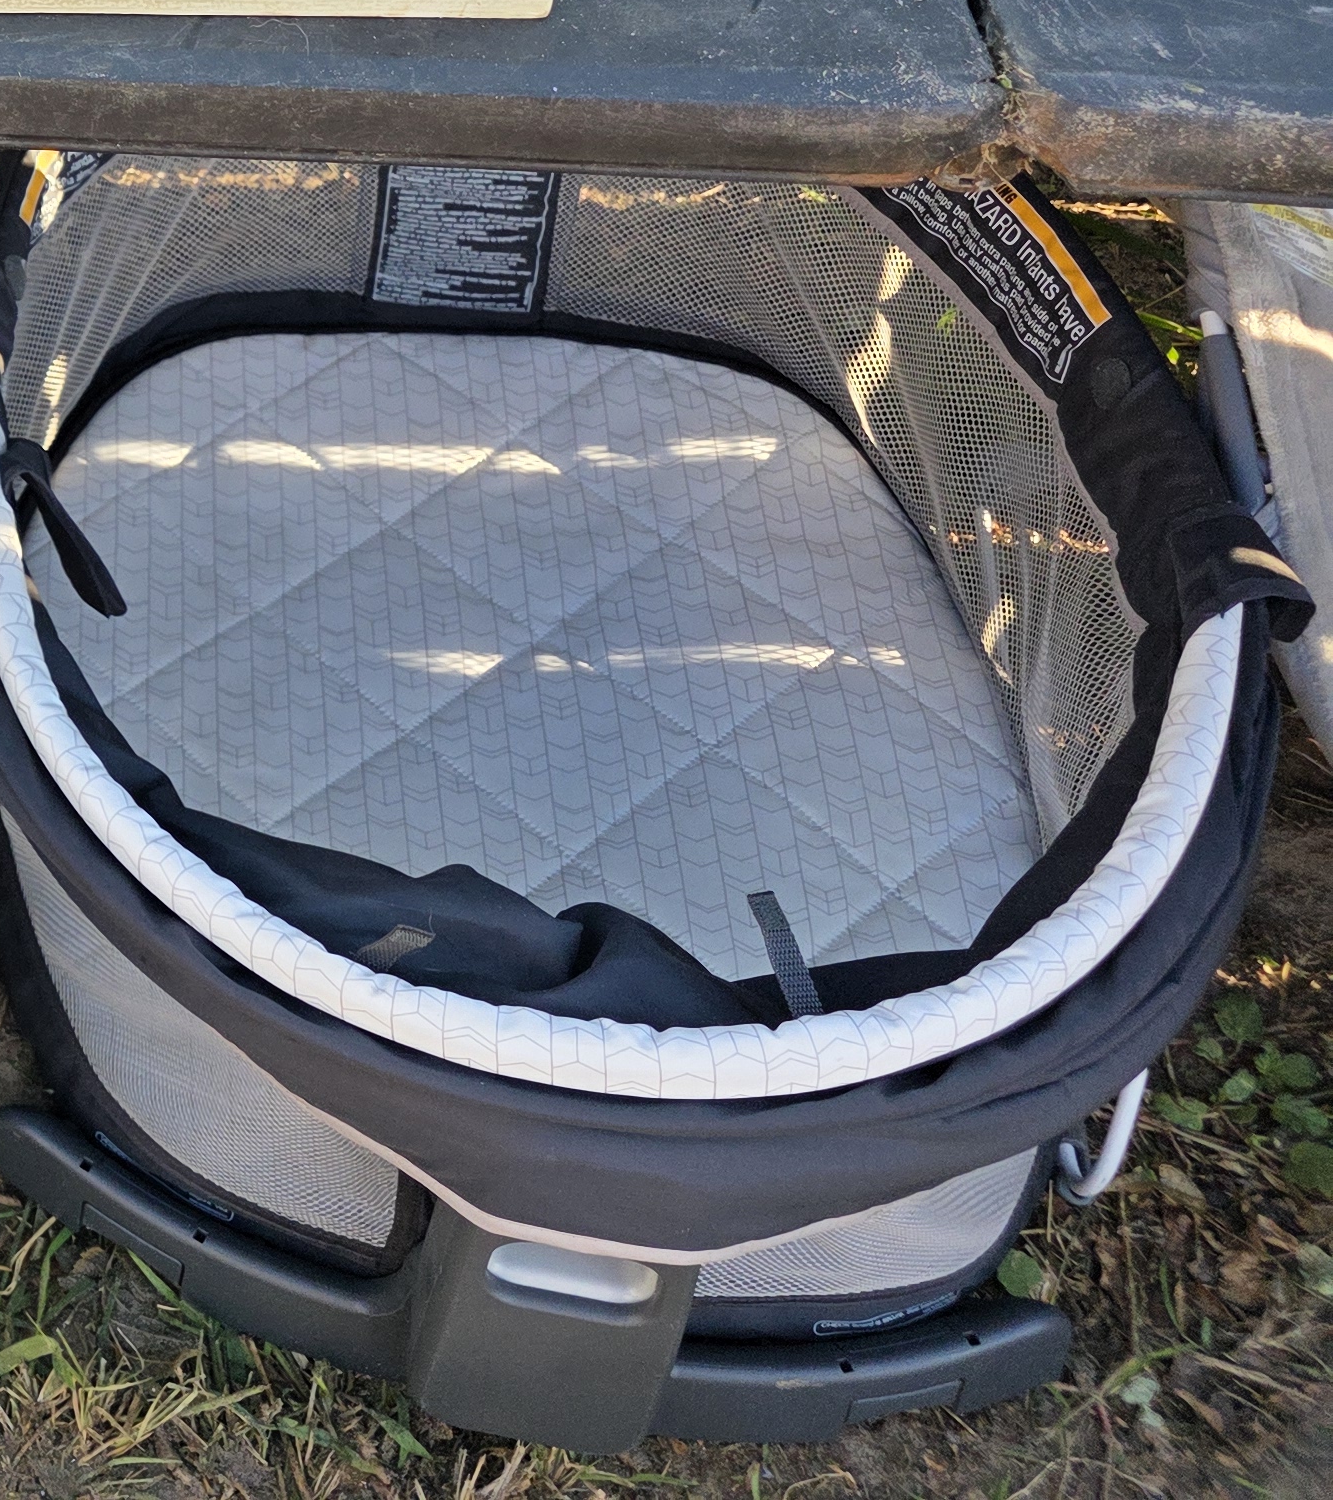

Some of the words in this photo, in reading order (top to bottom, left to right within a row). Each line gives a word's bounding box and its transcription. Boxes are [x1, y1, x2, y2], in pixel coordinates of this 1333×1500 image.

[957, 248, 969, 260] or
[967, 257, 997, 288] another
[962, 234, 984, 258] ONLY
[1009, 288, 1025, 308] pad
[979, 237, 1001, 261] extra
[1031, 303, 1050, 324] side
[1054, 293, 1086, 341] have
